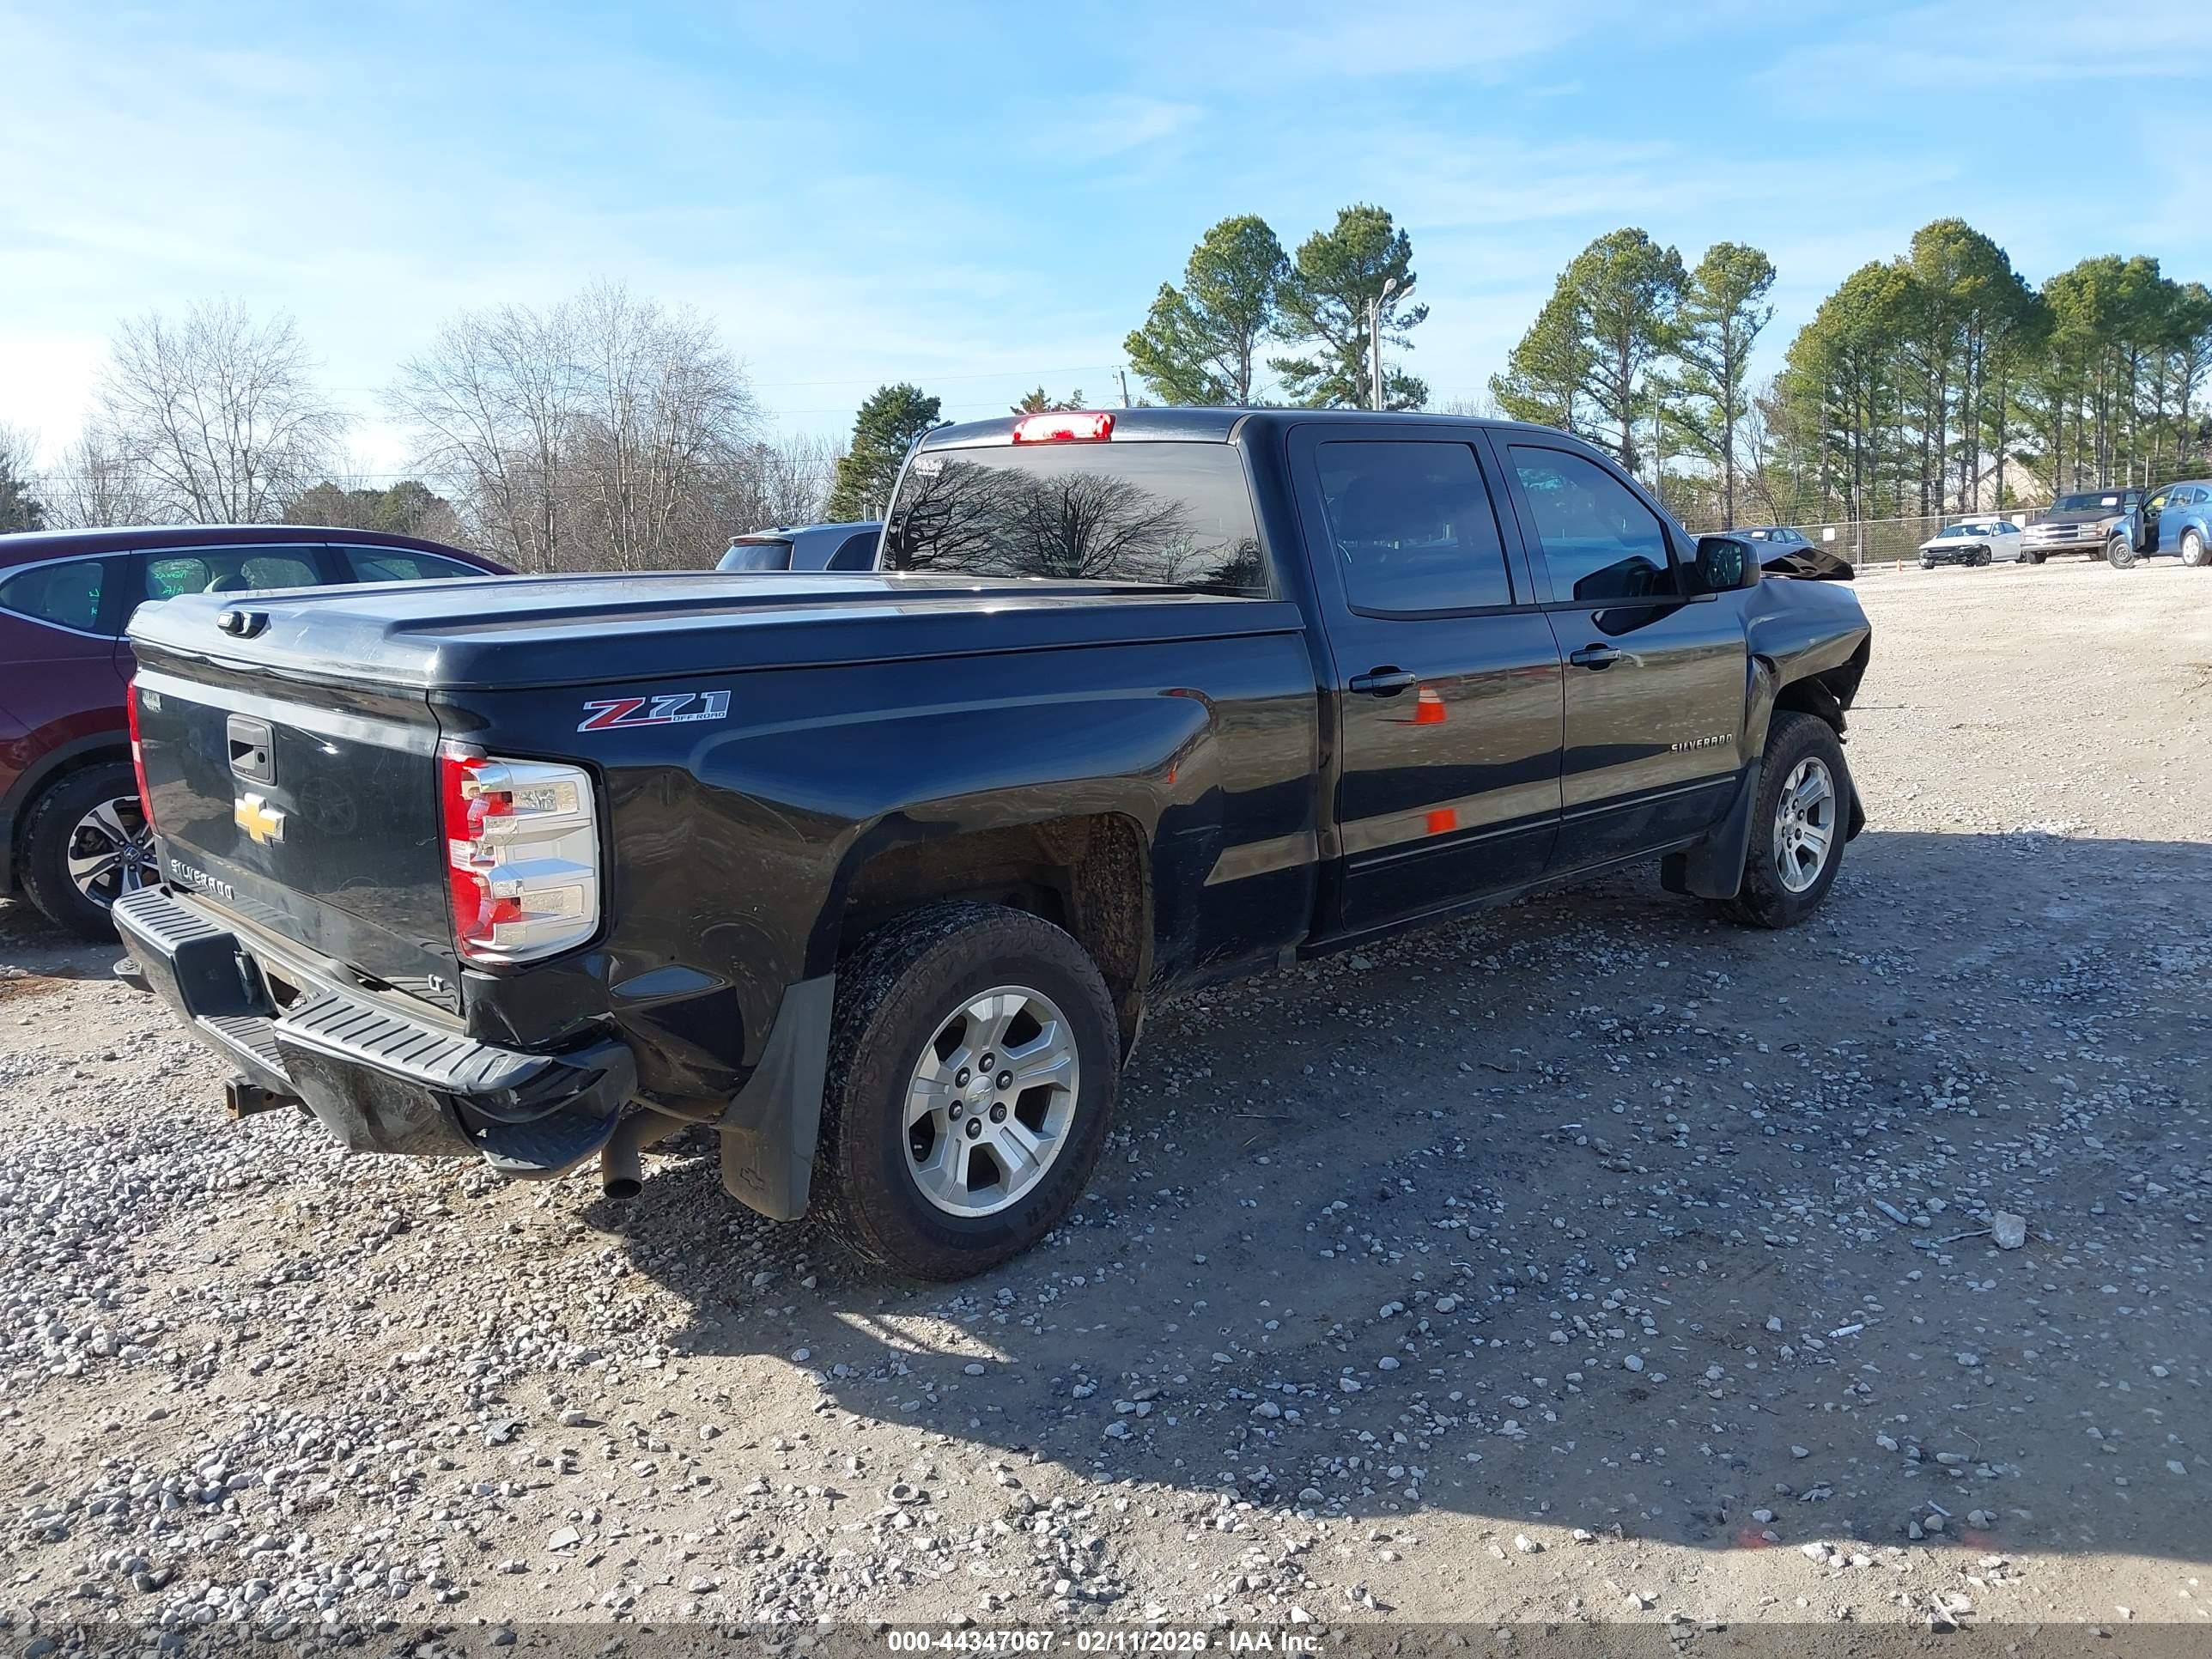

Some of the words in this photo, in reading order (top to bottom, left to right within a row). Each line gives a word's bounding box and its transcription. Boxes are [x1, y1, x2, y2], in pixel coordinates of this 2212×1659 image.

[577, 690, 731, 732] Z71
[696, 711, 726, 720] ROAD
[1671, 733, 1732, 754] SILVERADO
[171, 859, 234, 900] SILVERADO
[428, 974, 446, 992] LT
